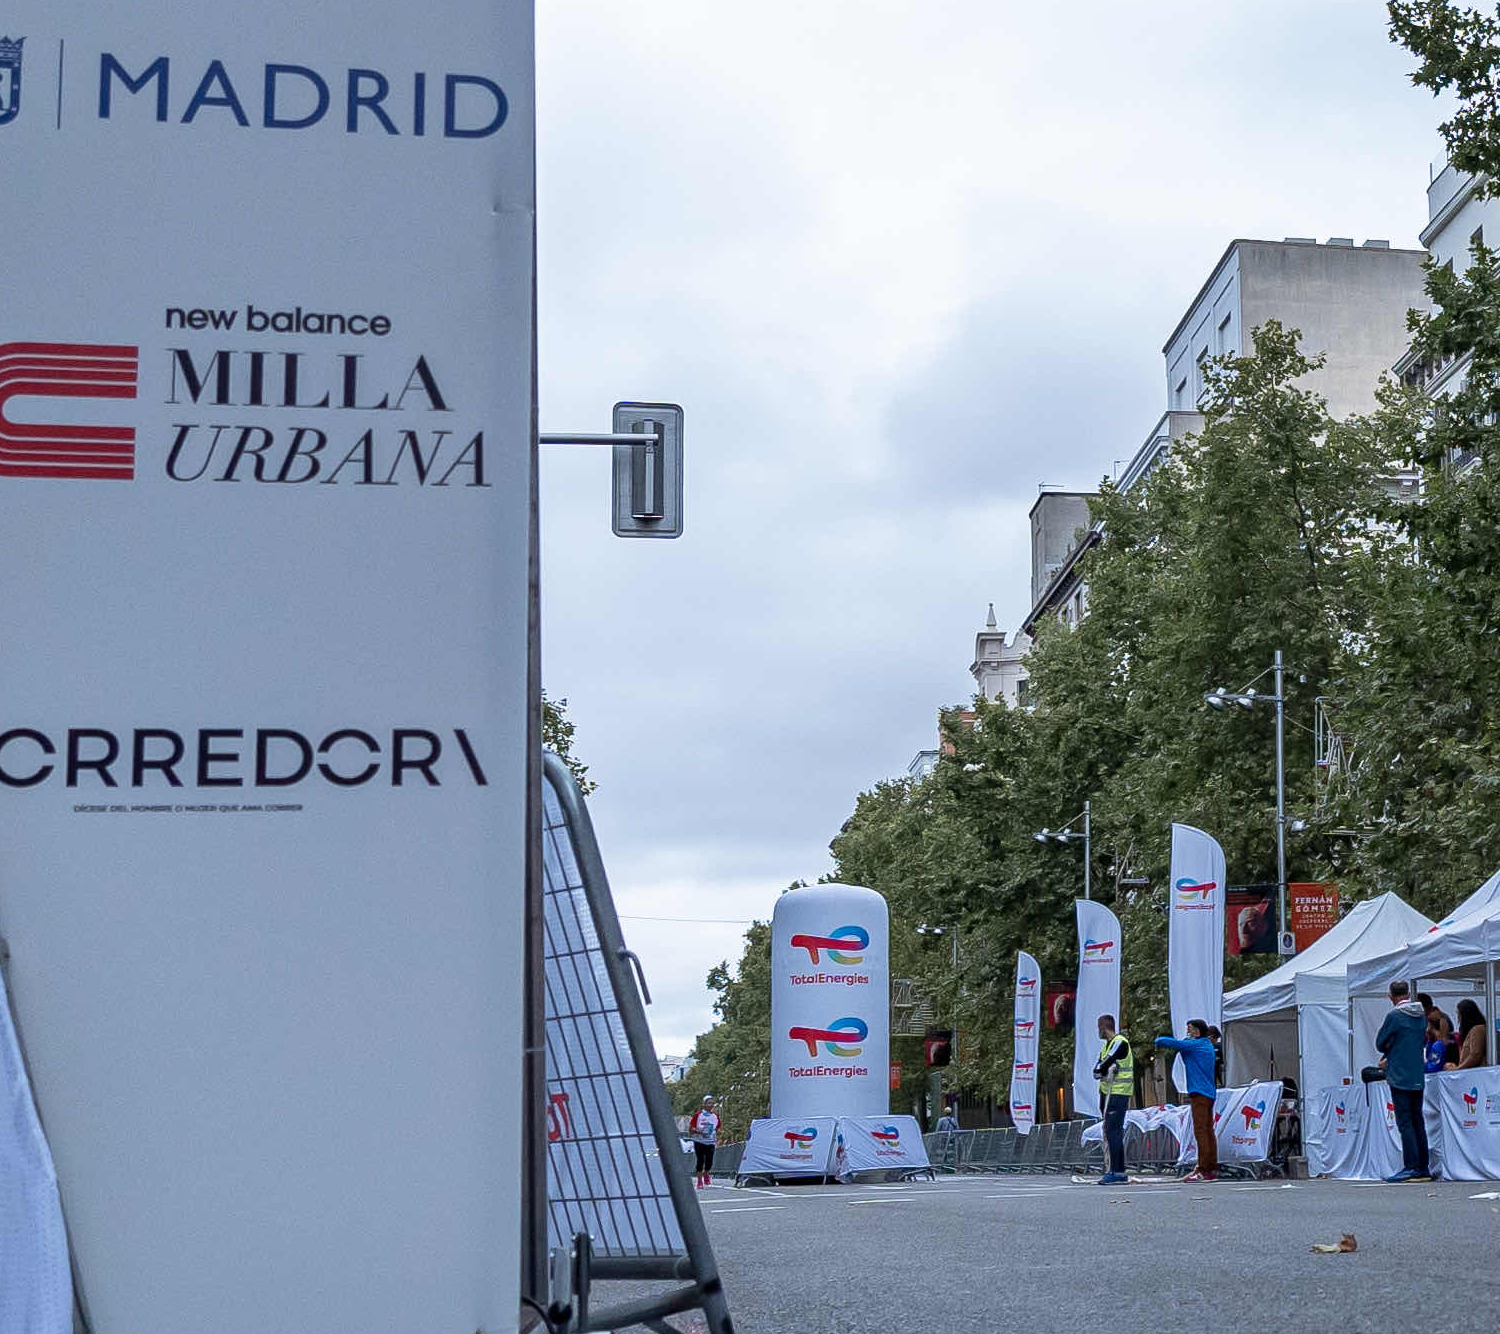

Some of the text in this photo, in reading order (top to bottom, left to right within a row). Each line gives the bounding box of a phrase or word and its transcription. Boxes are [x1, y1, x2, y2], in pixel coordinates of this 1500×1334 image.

[97, 51, 509, 139] MADRID
[164, 305, 391, 338] new balance
[164, 348, 453, 413] MILLA
[164, 423, 494, 488] URBANA
[790, 973, 869, 986] TotalEnergies
[789, 1065, 868, 1079] TotalEnergies
